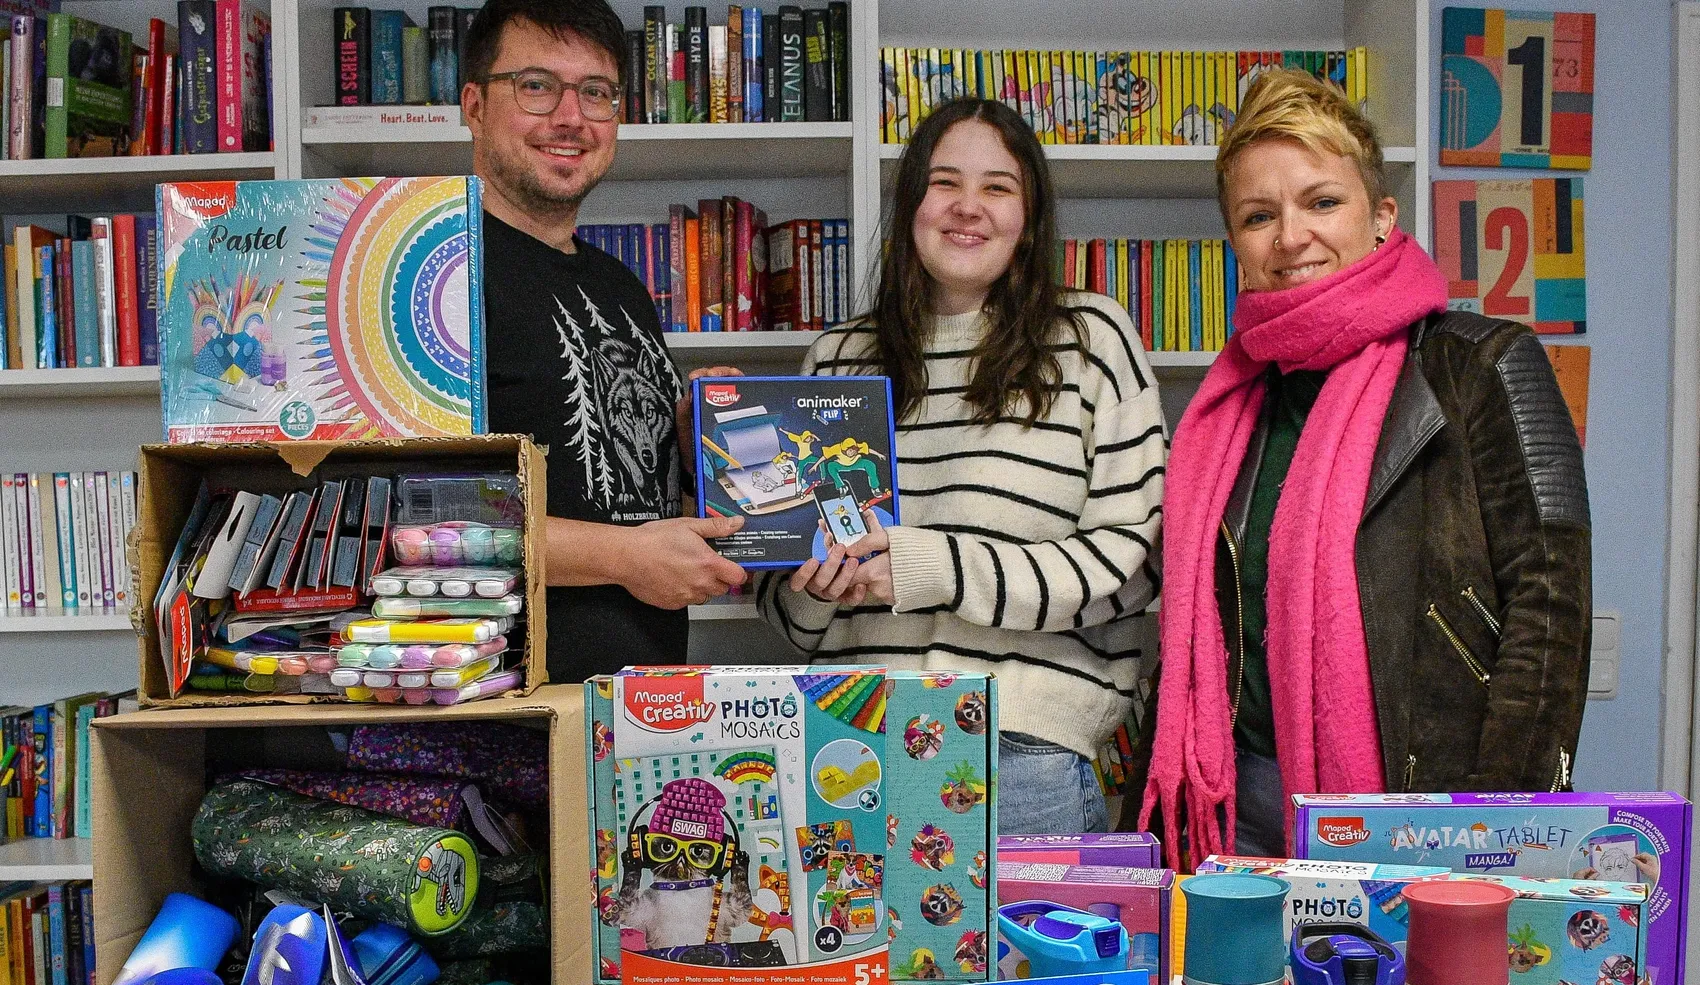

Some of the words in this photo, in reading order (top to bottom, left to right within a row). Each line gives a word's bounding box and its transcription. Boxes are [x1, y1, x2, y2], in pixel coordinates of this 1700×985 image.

[646, 19, 655, 42] CITY
[690, 26, 702, 63] HYDE
[340, 41, 358, 91] SCHEIN
[646, 43, 656, 81] OCEAN
[782, 33, 801, 117] ELANUS
[1508, 36, 1545, 146] 1
[207, 224, 289, 254] Pastel
[146, 229, 157, 310] DRACHENREITER
[1484, 206, 1530, 316] 2
[797, 395, 862, 408] animaker
[286, 403, 308, 424] 26
[180, 605, 188, 663] Maped
[634, 691, 683, 705] Maped
[721, 695, 798, 720] PHOTO
[674, 821, 705, 836] SWAG
[1323, 824, 1352, 833] Maped
[1494, 826, 1573, 848] TABLET
[1468, 854, 1515, 866] MANGA!
[1292, 897, 1363, 919] PHOTO
[819, 932, 836, 946] x4
[685, 975, 701, 983] Photo
[702, 975, 724, 983] mosaics
[810, 975, 823, 983] Foto
[855, 963, 886, 985] 5+
